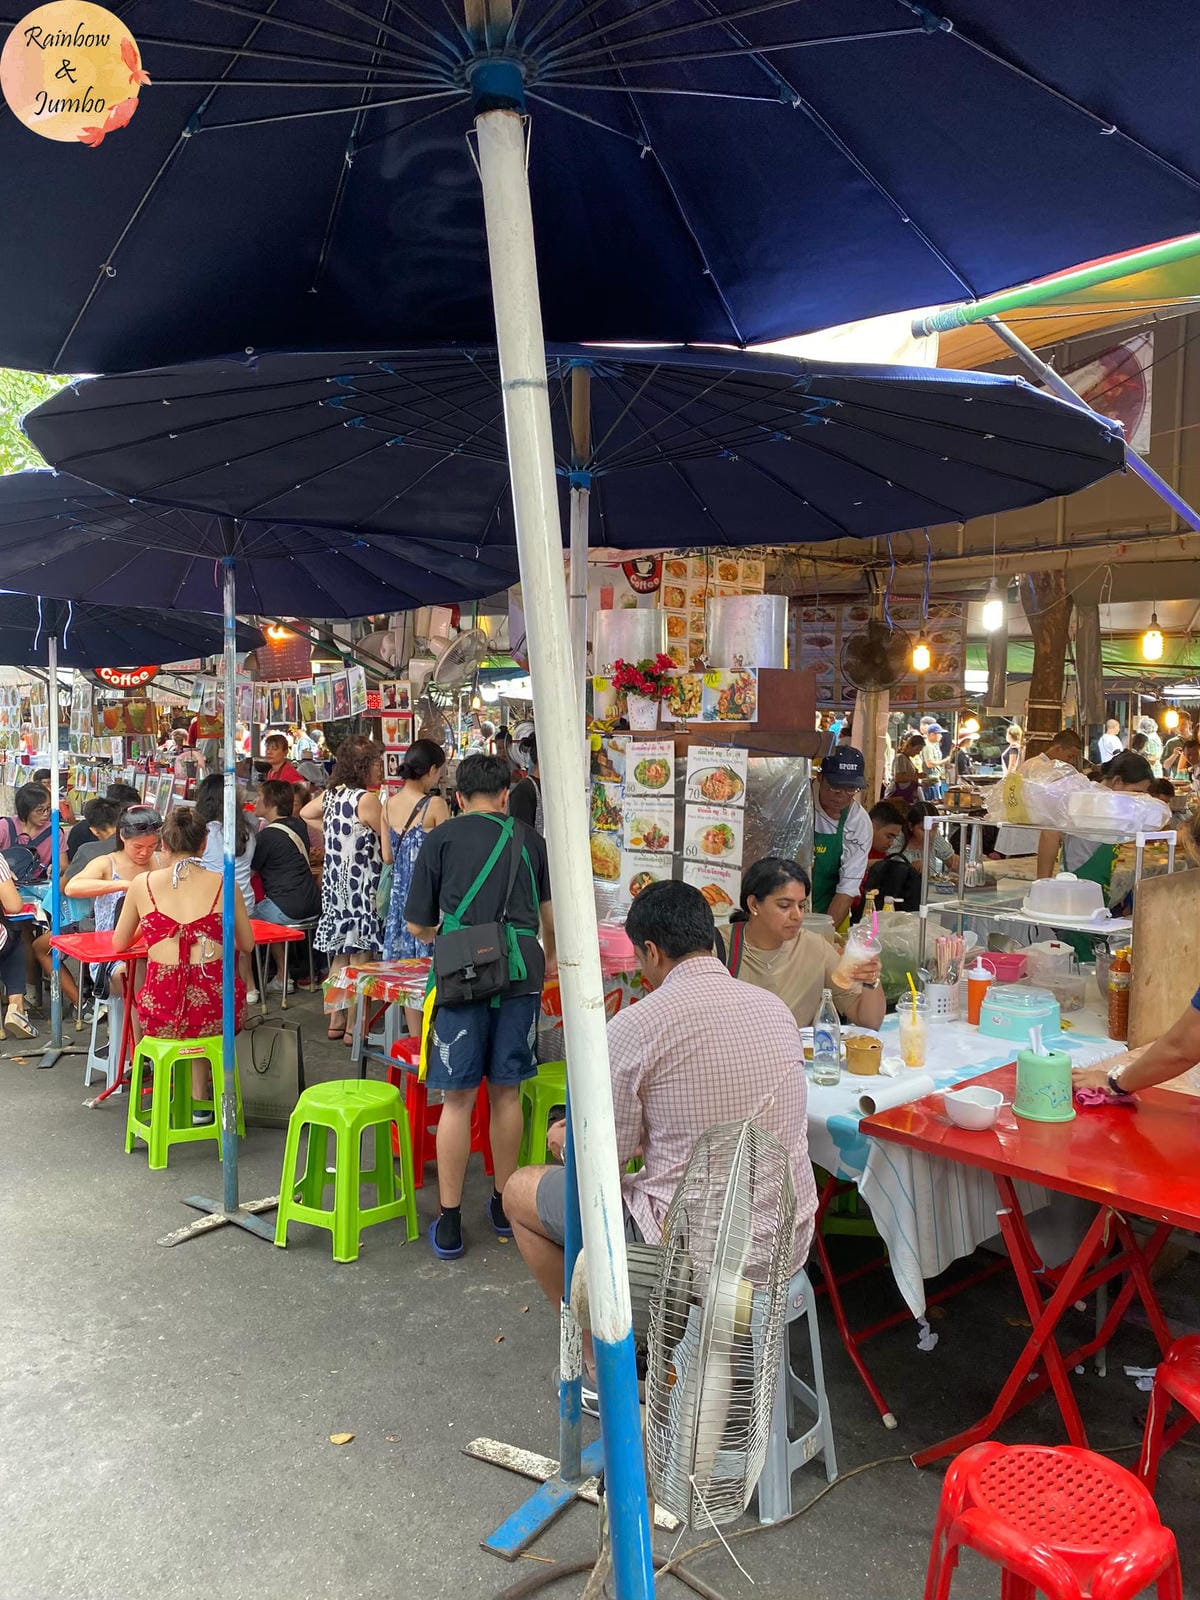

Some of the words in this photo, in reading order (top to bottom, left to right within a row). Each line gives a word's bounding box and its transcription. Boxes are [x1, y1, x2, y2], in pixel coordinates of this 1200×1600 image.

[630, 574, 660, 590] Coffee
[100, 667, 150, 686] Coffee
[839, 763, 858, 771] SPORT
[688, 787, 700, 800] 70
[685, 844, 698, 857] 60
